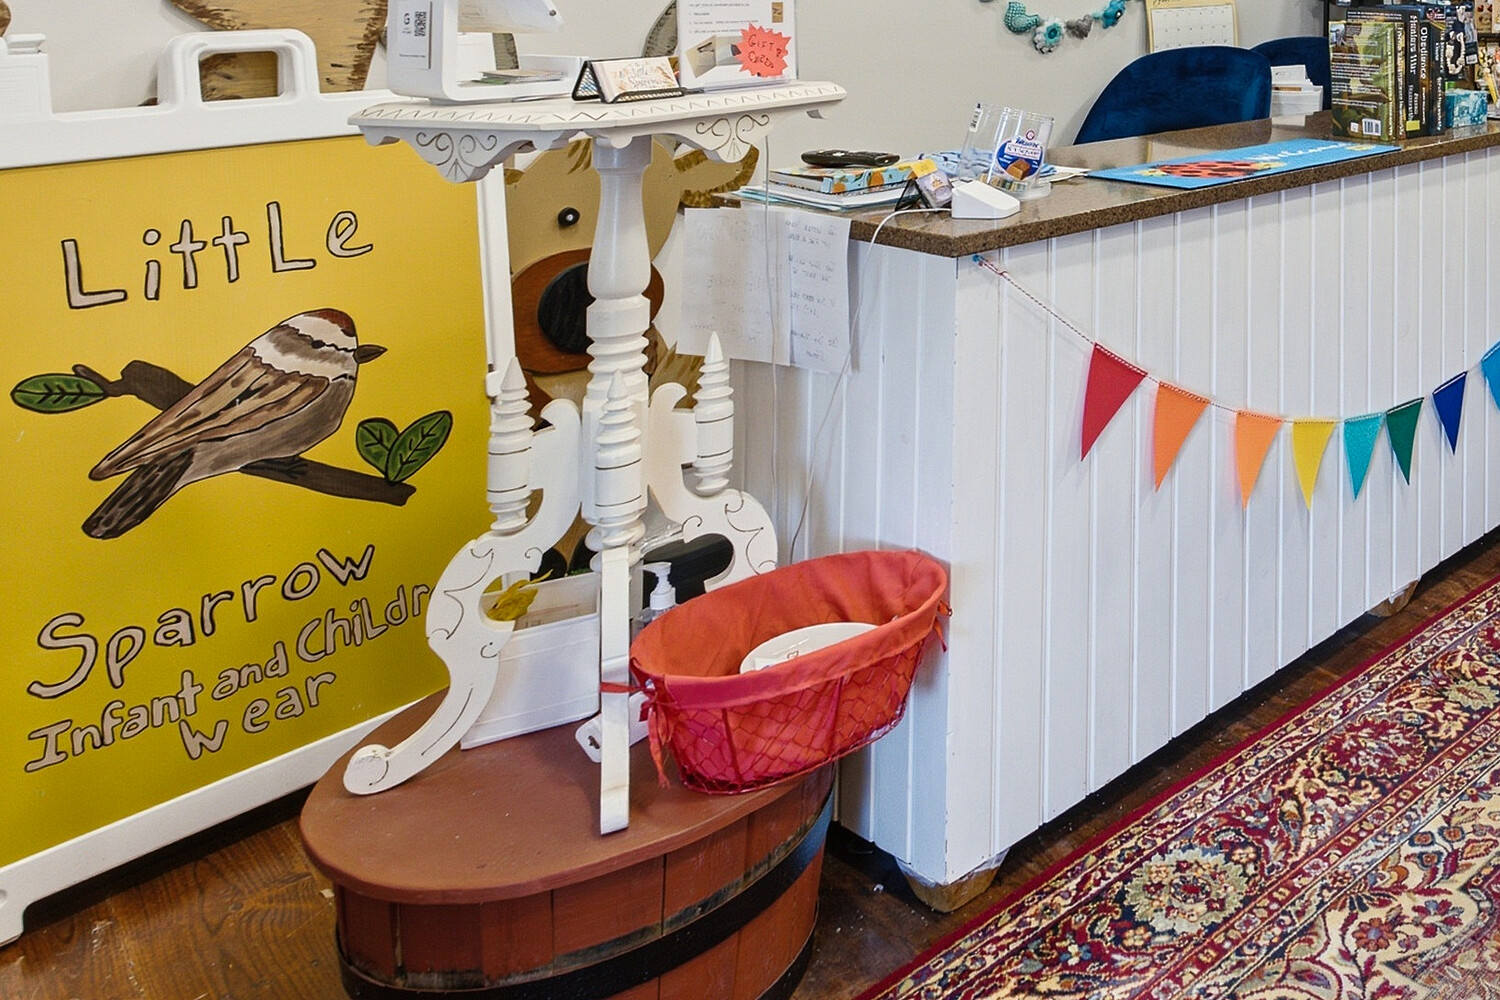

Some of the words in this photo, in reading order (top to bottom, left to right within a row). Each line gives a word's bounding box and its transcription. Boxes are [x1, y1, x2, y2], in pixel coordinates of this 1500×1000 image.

[748, 34, 774, 50] GIFT
[1420, 27, 1428, 79] Obedience
[26, 543, 376, 699] Sparrow
[24, 671, 204, 774] Infant
[212, 640, 289, 701] and
